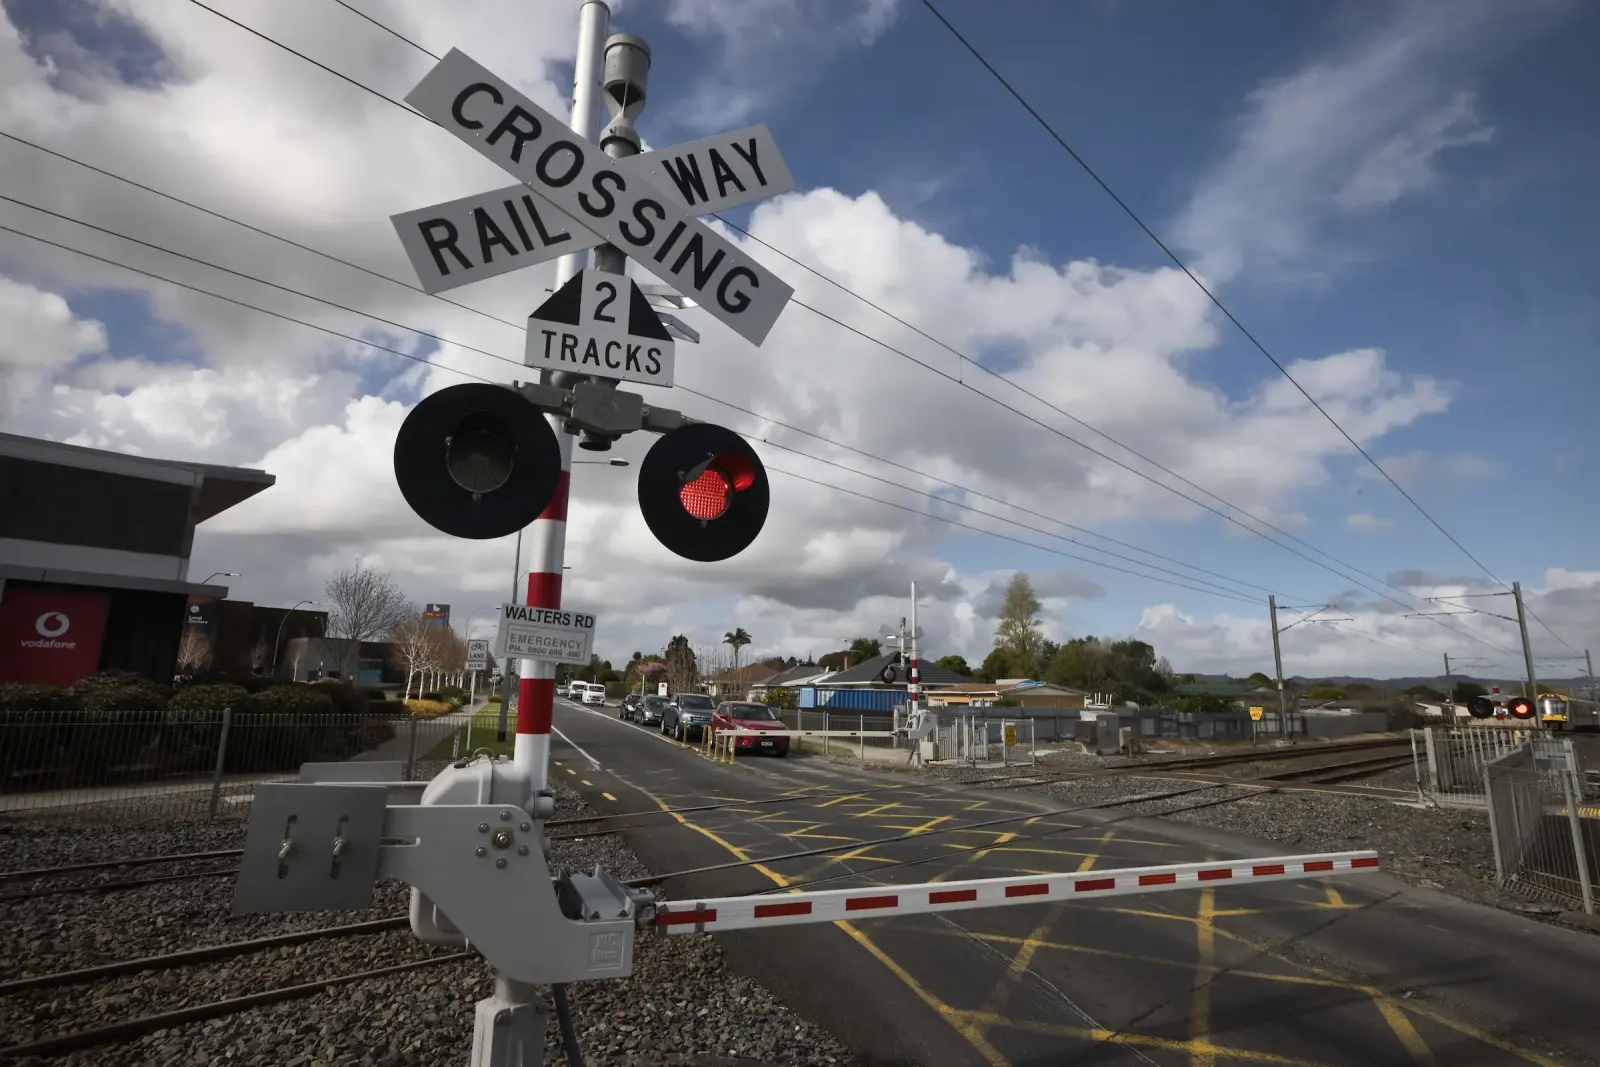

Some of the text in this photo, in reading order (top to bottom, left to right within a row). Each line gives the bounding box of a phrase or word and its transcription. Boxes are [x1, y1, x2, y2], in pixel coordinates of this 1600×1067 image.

[417, 137, 768, 276] RAIL WAY
[451, 82, 760, 314] CROSSING
[593, 281, 617, 323] 2
[541, 329, 662, 375] TRACKS
[505, 605, 594, 629] WALTERS RD
[21, 639, 76, 649] vodafone
[509, 633, 584, 650] EMERGENCY
